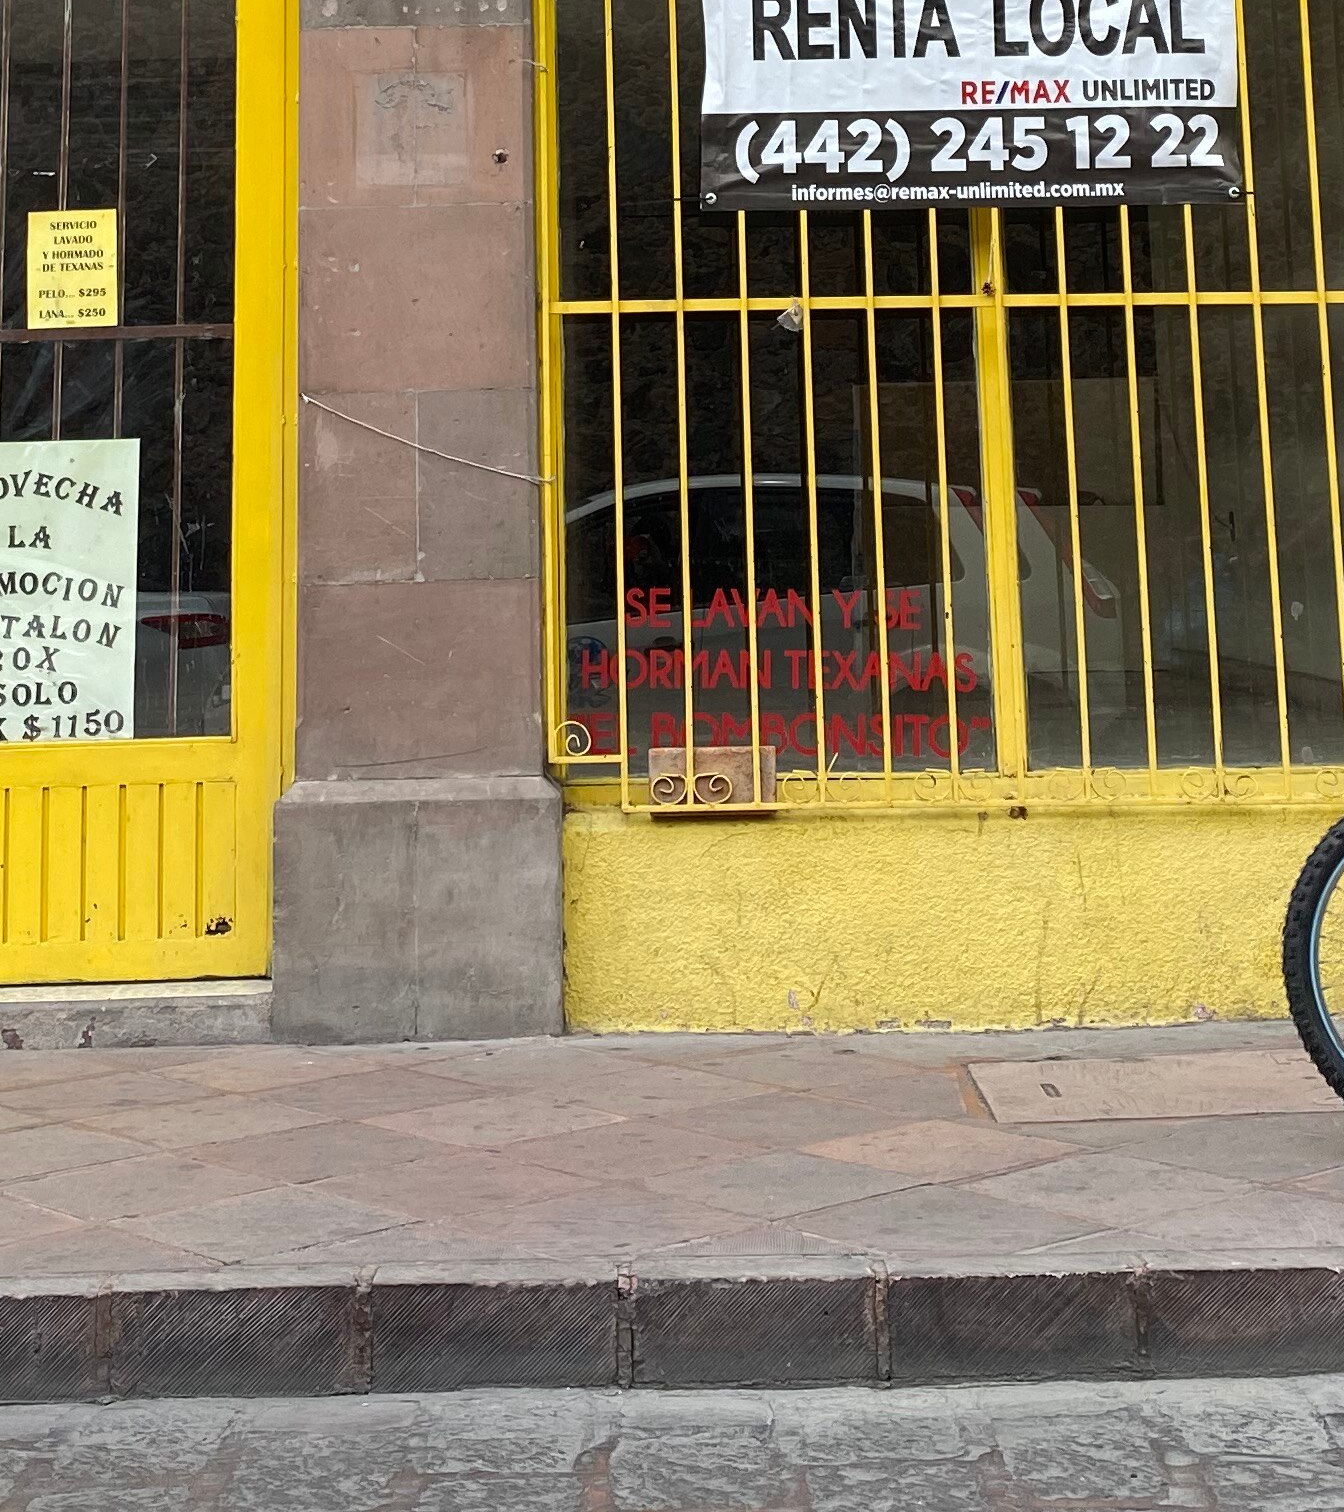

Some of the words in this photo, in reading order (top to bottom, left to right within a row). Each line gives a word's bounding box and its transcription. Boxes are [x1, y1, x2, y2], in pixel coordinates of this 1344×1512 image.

[960, 79, 1071, 105] RE/MAX
[1082, 78, 1215, 103] UNLIMITED
[734, 117, 911, 185] (442)
[929, 116, 1048, 174] 245
[1066, 114, 1131, 170] 12
[1149, 113, 1225, 169] 22
[791, 181, 1125, 204] informes@remax-unlimited.com.mx
[50, 220, 97, 230] SERVICIO
[53, 235, 93, 245] LAVADO
[42, 251, 49, 260] Y
[52, 249, 104, 259] HORMADO
[42, 263, 56, 272] DE
[59, 262, 104, 272] TEXANAS
[78, 287, 106, 298] $295
[78, 307, 106, 318] $250
[7, 525, 52, 550] LA
[625, 587, 672, 628] SE
[831, 588, 863, 629] Y
[874, 589, 922, 630] SE
[581, 648, 771, 690] HORMAN
[784, 649, 978, 694] TEXANAS
